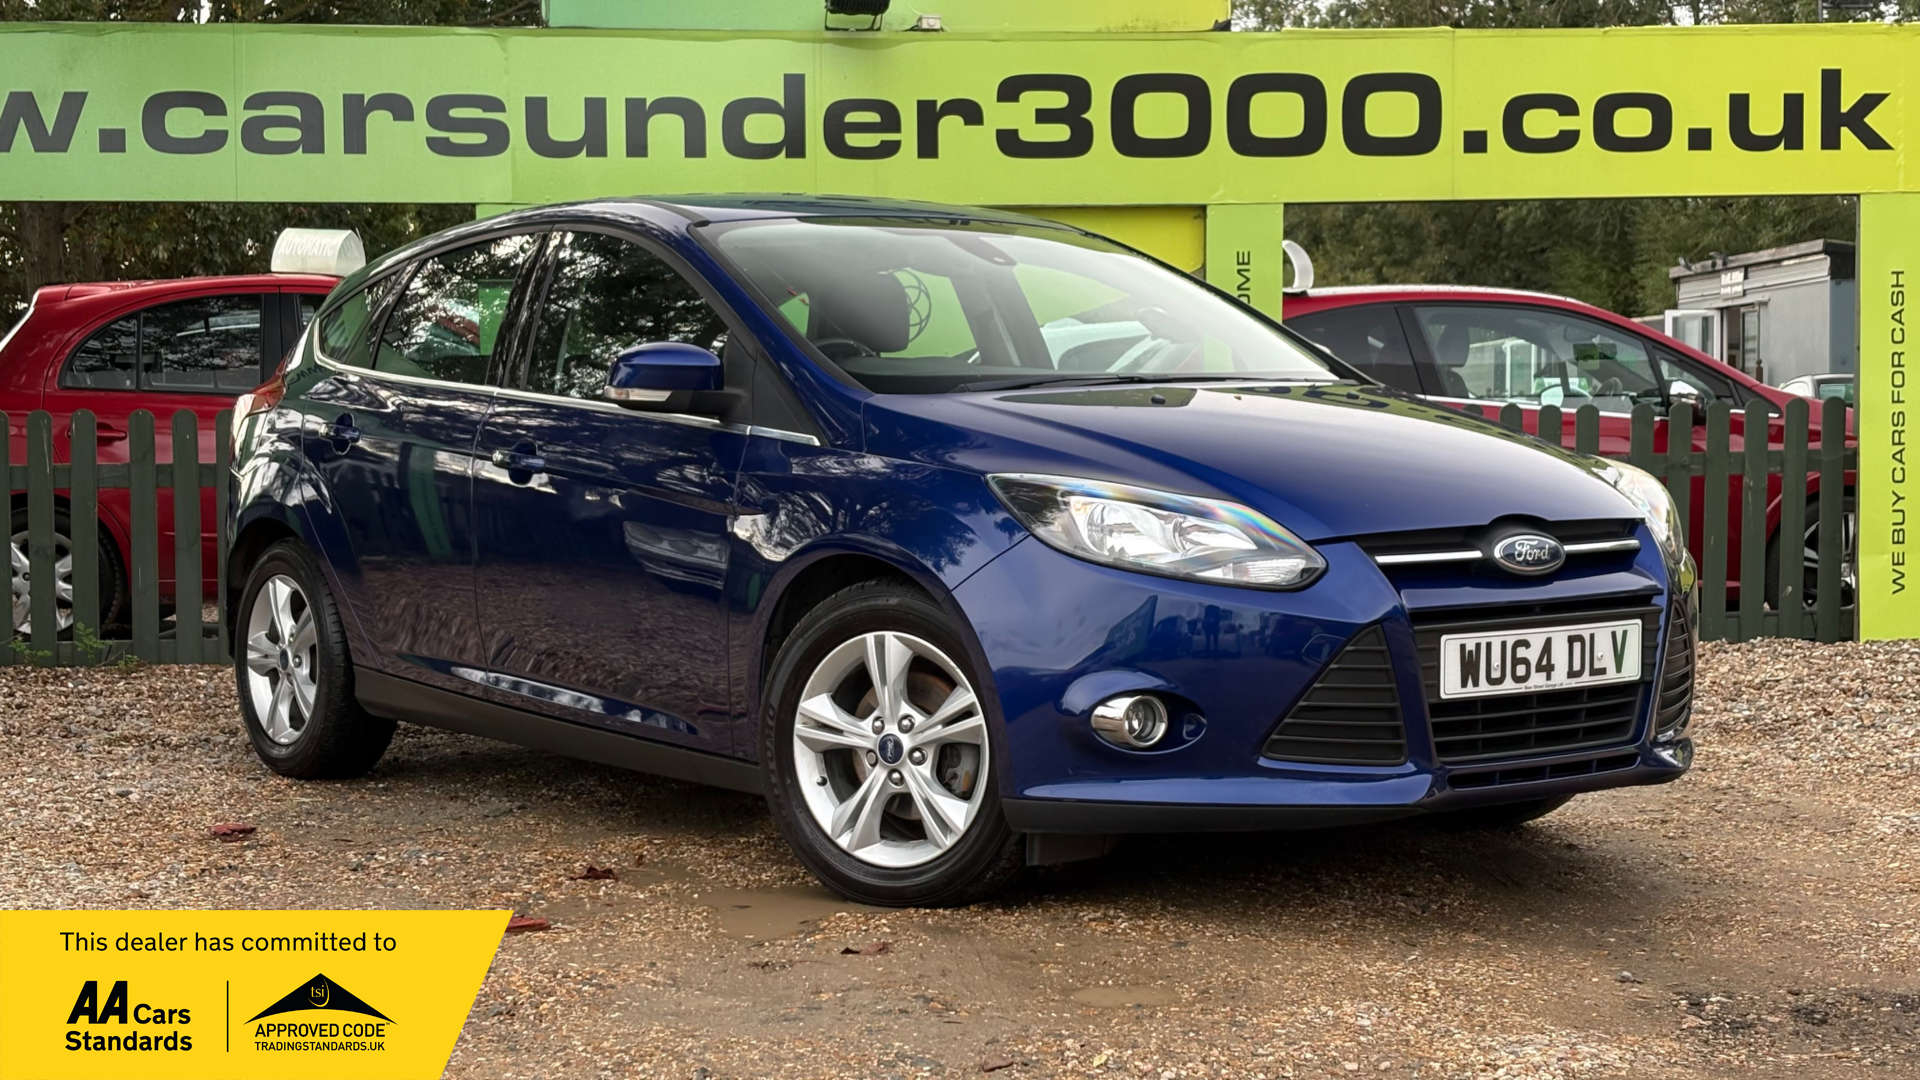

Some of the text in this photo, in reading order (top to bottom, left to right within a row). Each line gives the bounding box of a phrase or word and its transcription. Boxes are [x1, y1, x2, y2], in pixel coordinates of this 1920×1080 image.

[1891, 271, 1905, 594] WE BUY CARS FOR CASH
[1514, 540, 1550, 562] Ford
[1460, 630, 1628, 689] WU64 DLV
